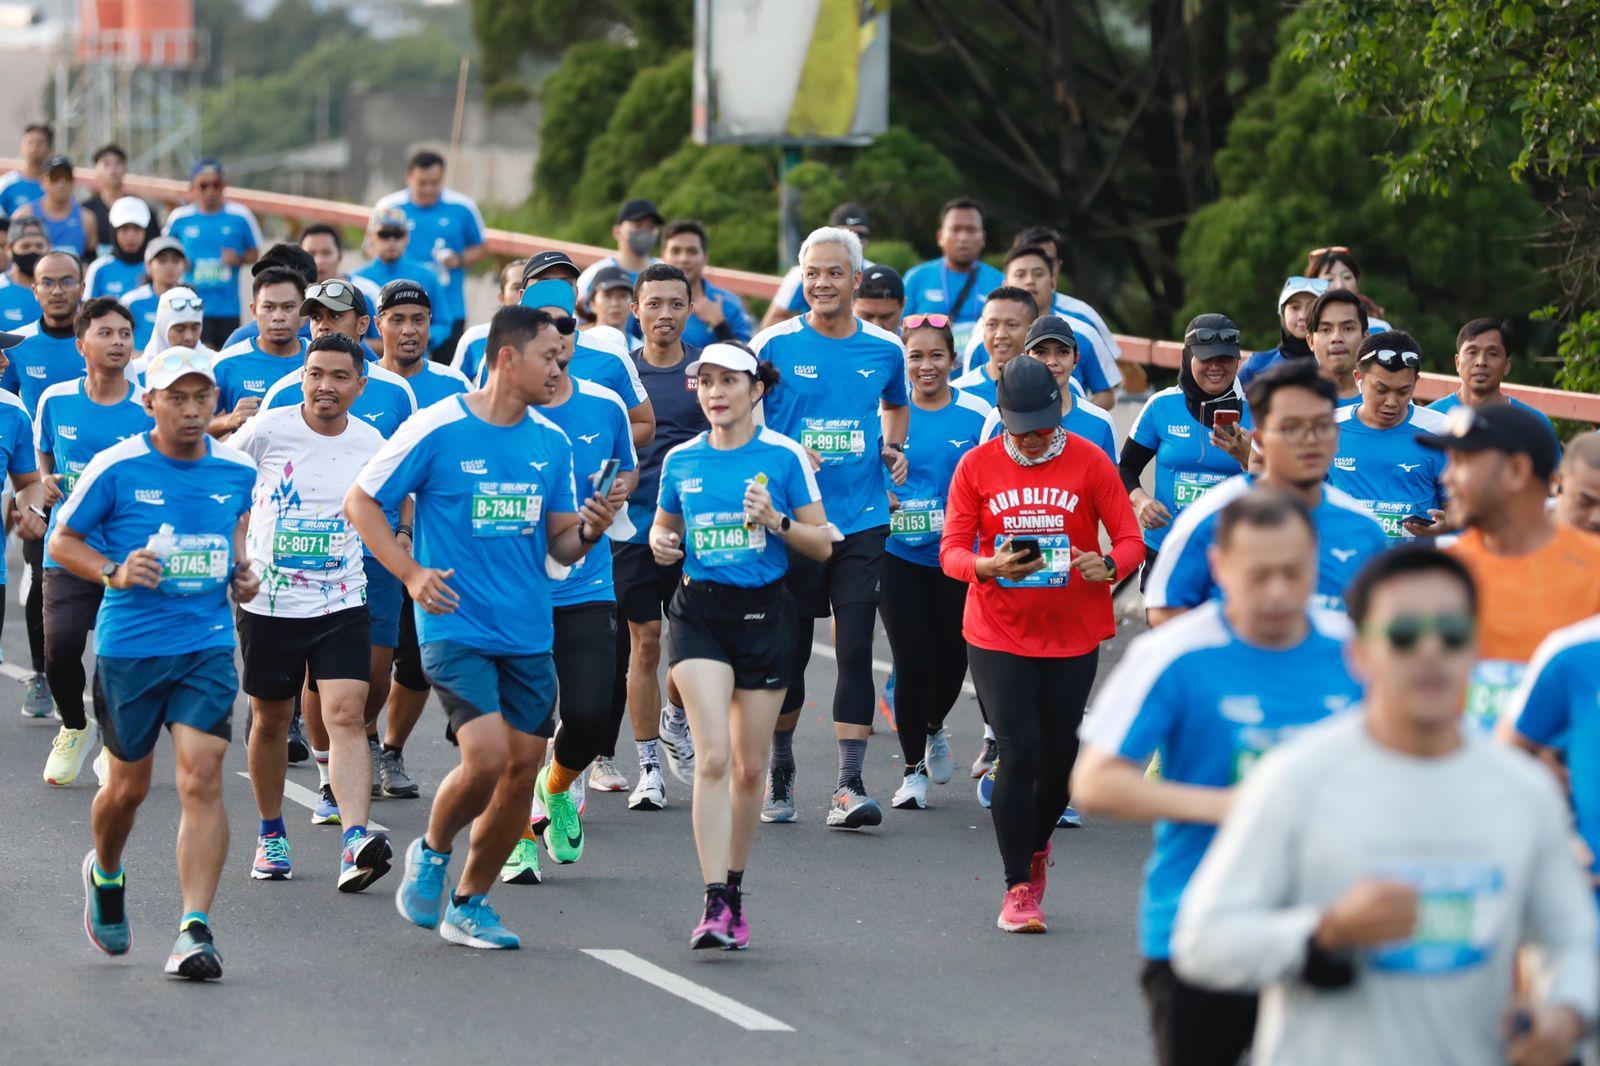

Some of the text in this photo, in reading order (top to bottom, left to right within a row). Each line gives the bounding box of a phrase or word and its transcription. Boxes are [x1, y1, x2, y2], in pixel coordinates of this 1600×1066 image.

[394, 290, 419, 300] RUNNER
[804, 433, 848, 450] B-8916
[477, 499, 523, 518] B-7341
[990, 487, 1079, 516] RUN BLITAR
[332, 522, 339, 531] 9
[1003, 515, 1064, 529] RUNNING
[278, 535, 325, 553] C-8071
[694, 528, 744, 549] B-7148
